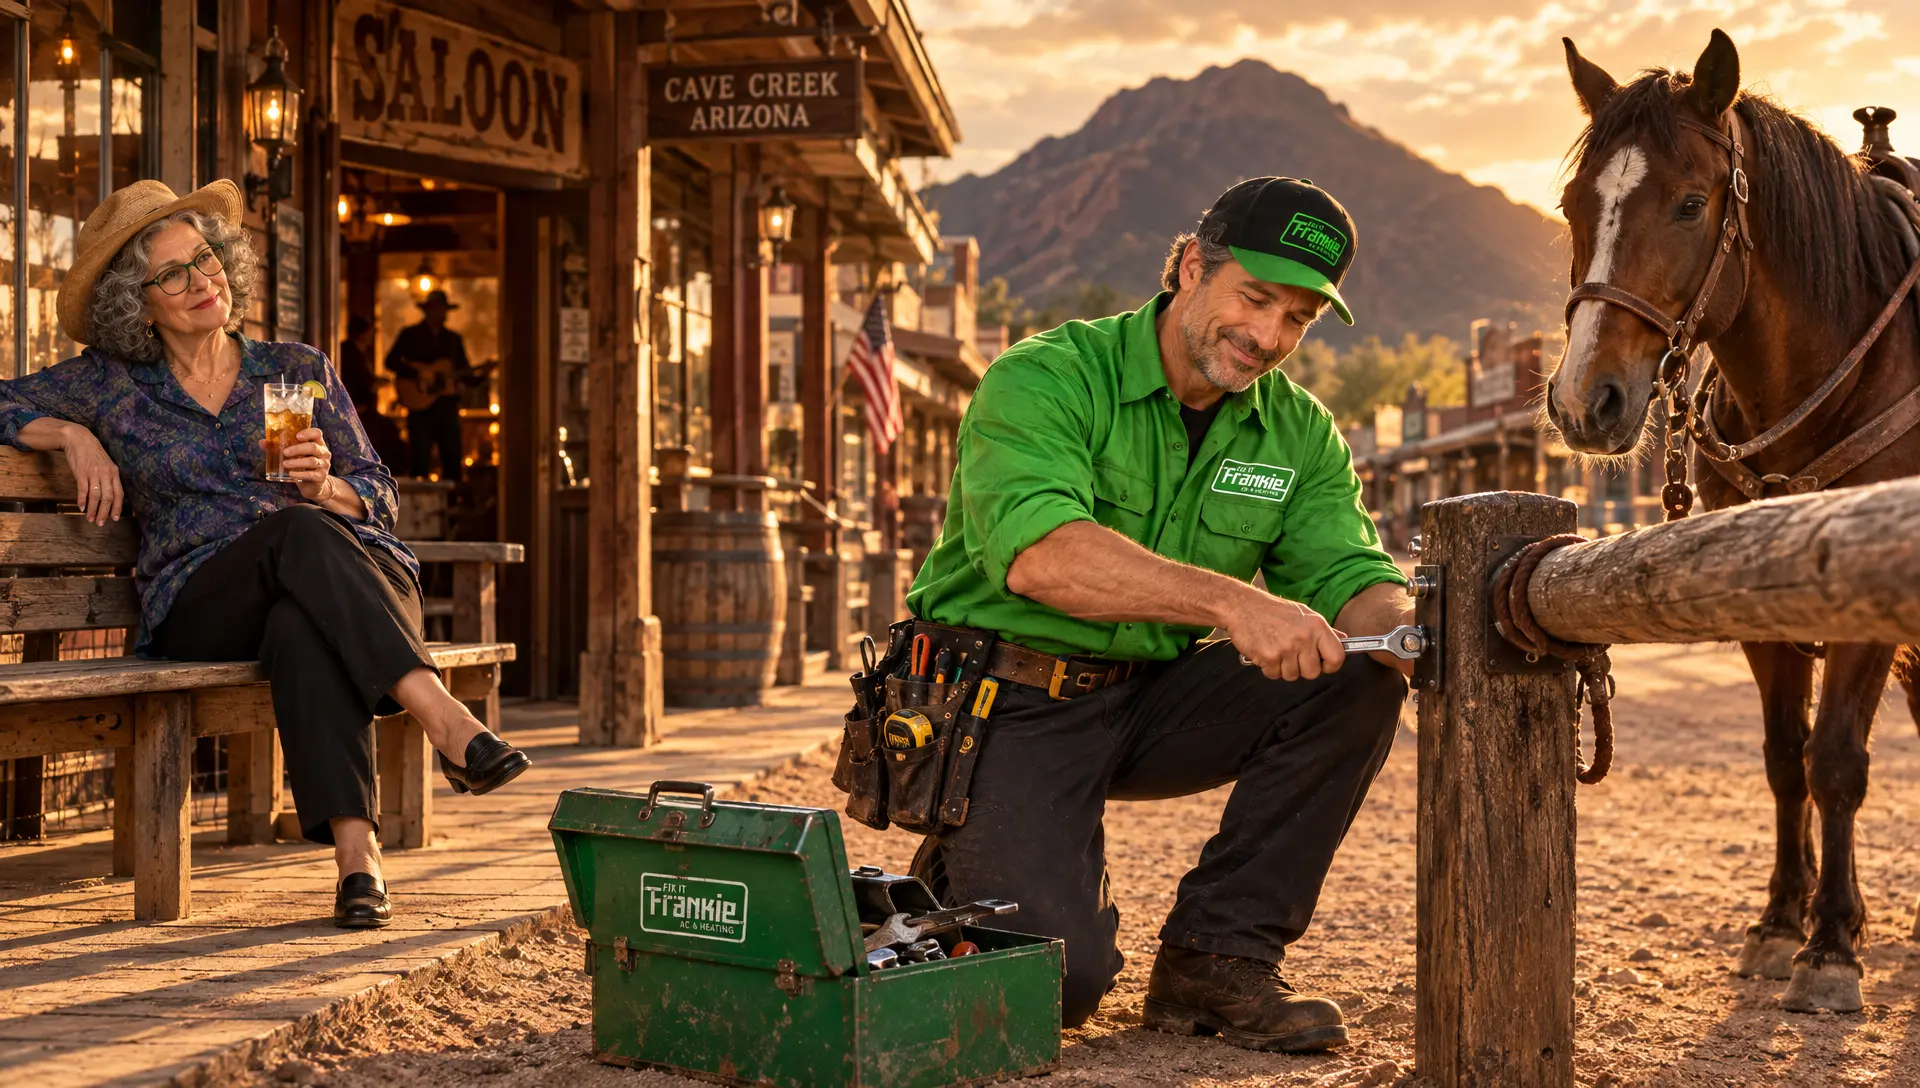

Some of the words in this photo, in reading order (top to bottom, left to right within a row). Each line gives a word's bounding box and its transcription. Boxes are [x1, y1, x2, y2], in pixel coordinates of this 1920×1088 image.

[353, 12, 567, 154] SALOON
[664, 74, 735, 102] CAVE
[749, 71, 839, 98] CREEK
[690, 103, 810, 131] ARIZONA
[1221, 467, 1287, 492] Frankie
[678, 884, 687, 893] IT
[644, 886, 744, 925] Frankie
[680, 921, 690, 929] AC
[700, 924, 735, 934] HEATING
